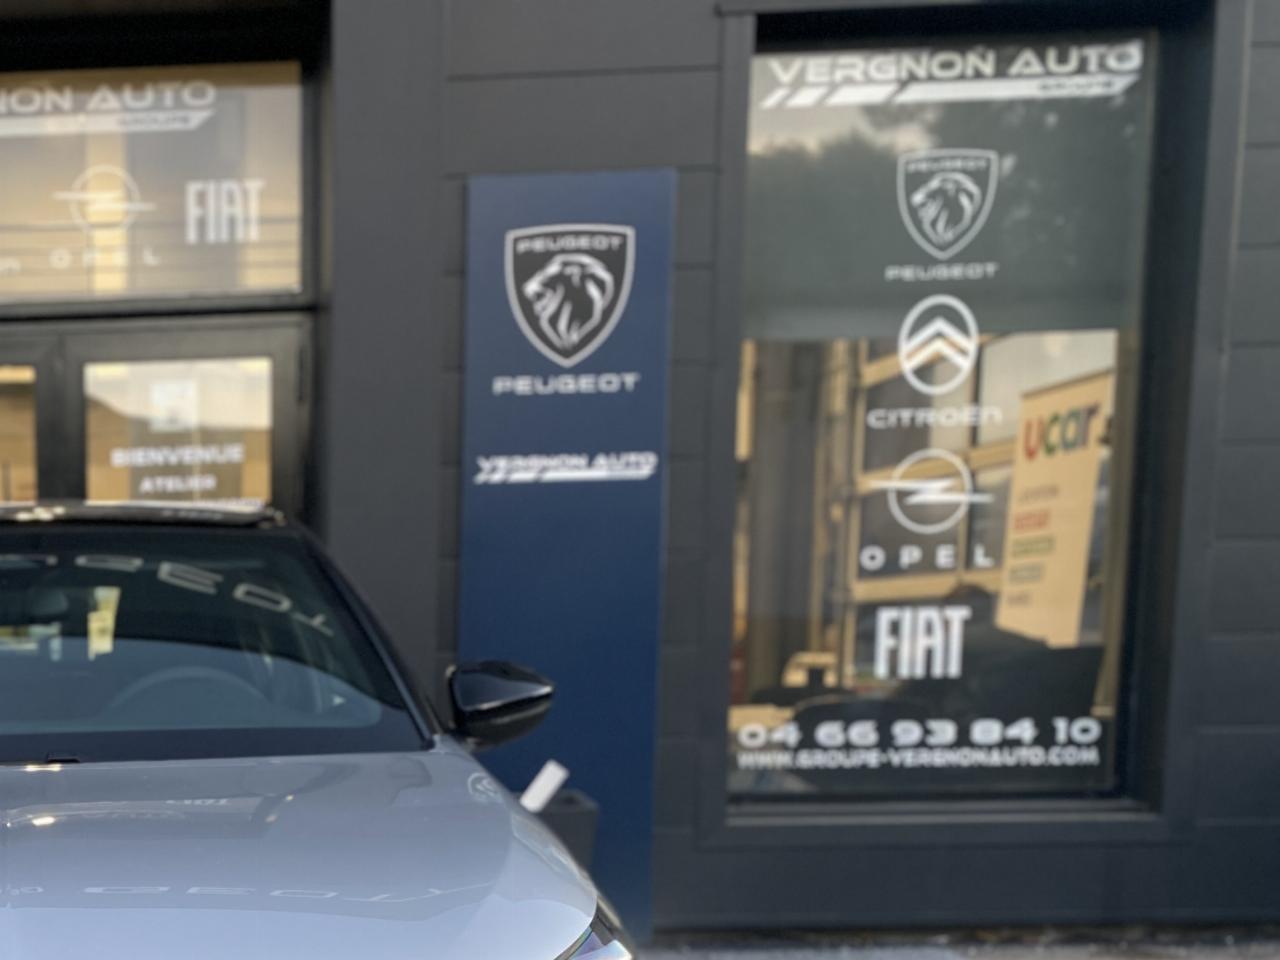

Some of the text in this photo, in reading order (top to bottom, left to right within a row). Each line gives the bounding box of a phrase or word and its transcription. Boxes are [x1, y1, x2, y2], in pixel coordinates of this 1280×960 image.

[768, 38, 1143, 84] VERGNON AUTO
[85, 79, 216, 112] AUTO
[186, 177, 266, 244] FIAT
[516, 234, 624, 254] PEUGEOT
[884, 262, 999, 281] PEUGEOT
[492, 372, 641, 396] PEUGEOT
[1023, 403, 1100, 461] ucar
[110, 442, 245, 468] BIENVENUE
[859, 543, 994, 571] OPEL
[874, 605, 971, 680] FIAT
[737, 721, 802, 749] 04
[814, 719, 879, 748] 66
[891, 719, 958, 748] 93
[1053, 716, 1102, 745] 10
